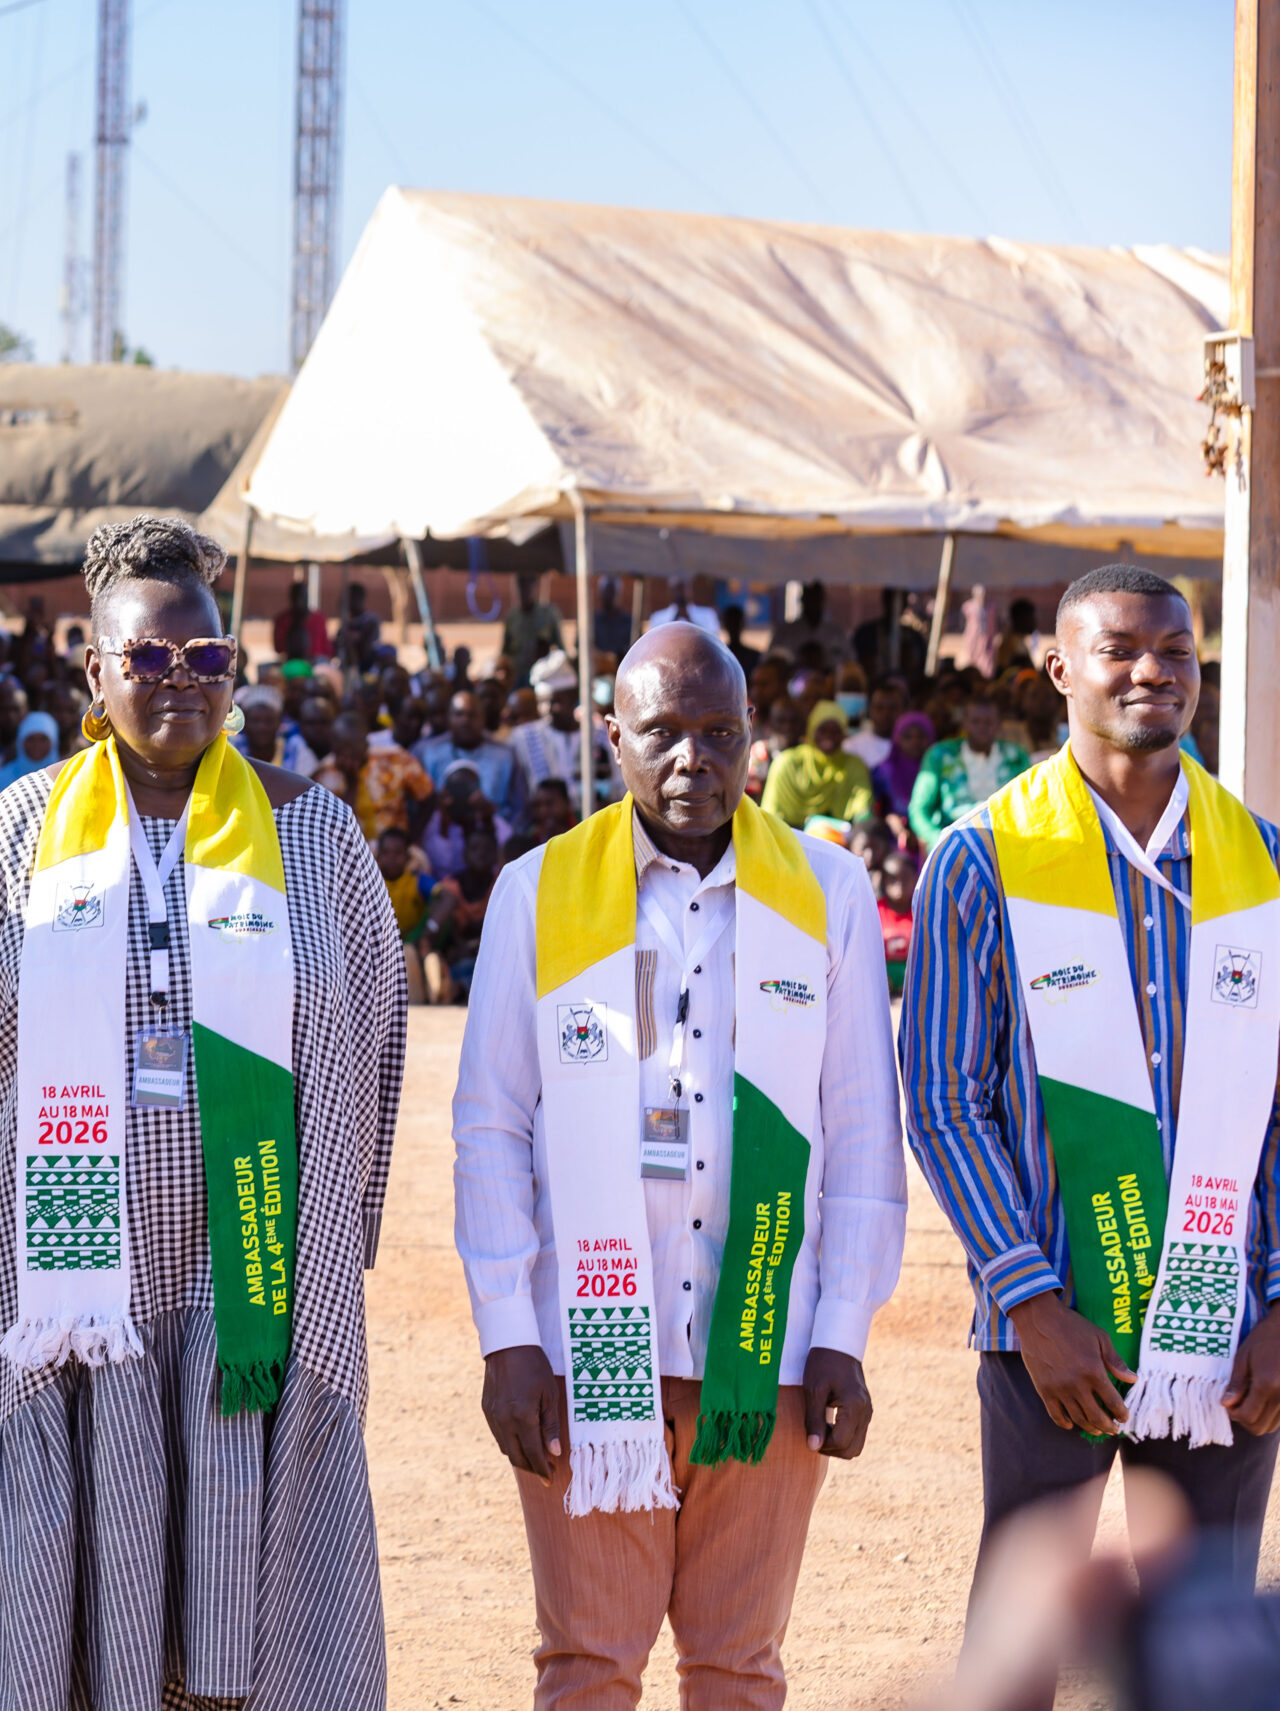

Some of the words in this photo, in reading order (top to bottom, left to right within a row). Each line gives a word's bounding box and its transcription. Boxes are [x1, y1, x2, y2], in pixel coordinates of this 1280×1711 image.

[1047, 970, 1096, 988] PATRIMOINE
[1072, 964, 1084, 973] DU
[775, 987, 815, 1001] PATRIMOINE
[797, 983, 808, 991] DU
[42, 1085, 57, 1099] 18
[60, 1085, 106, 1098] AVRIL
[38, 1105, 60, 1119] AU
[63, 1104, 78, 1119] 18
[81, 1104, 109, 1118] MAI
[37, 1120, 109, 1145] 2026
[259, 1140, 282, 1217] ÉDITION
[1191, 1174, 1203, 1188] 18
[1204, 1176, 1238, 1192] AVRIL
[1117, 1173, 1152, 1251] ÉDITION
[1185, 1194, 1202, 1208] AU
[1205, 1196, 1217, 1209] 18
[1220, 1198, 1238, 1211] MAI
[234, 1156, 266, 1306] AMBASSADEUR
[767, 1192, 791, 1266] ÉDITION
[1182, 1209, 1235, 1236] 2026
[577, 1239, 591, 1253] 18
[593, 1239, 633, 1252] AVRIL
[270, 1258, 286, 1285] LA
[577, 1259, 595, 1272] AU
[597, 1258, 609, 1272] 18
[610, 1257, 638, 1270] MAI
[1091, 1191, 1133, 1334] AMBASSADEUR
[576, 1272, 638, 1298] 2026
[739, 1203, 770, 1352] AMBASSADEUR
[272, 1288, 287, 1315] DE
[761, 1309, 775, 1334] LA
[759, 1339, 772, 1365] DE
